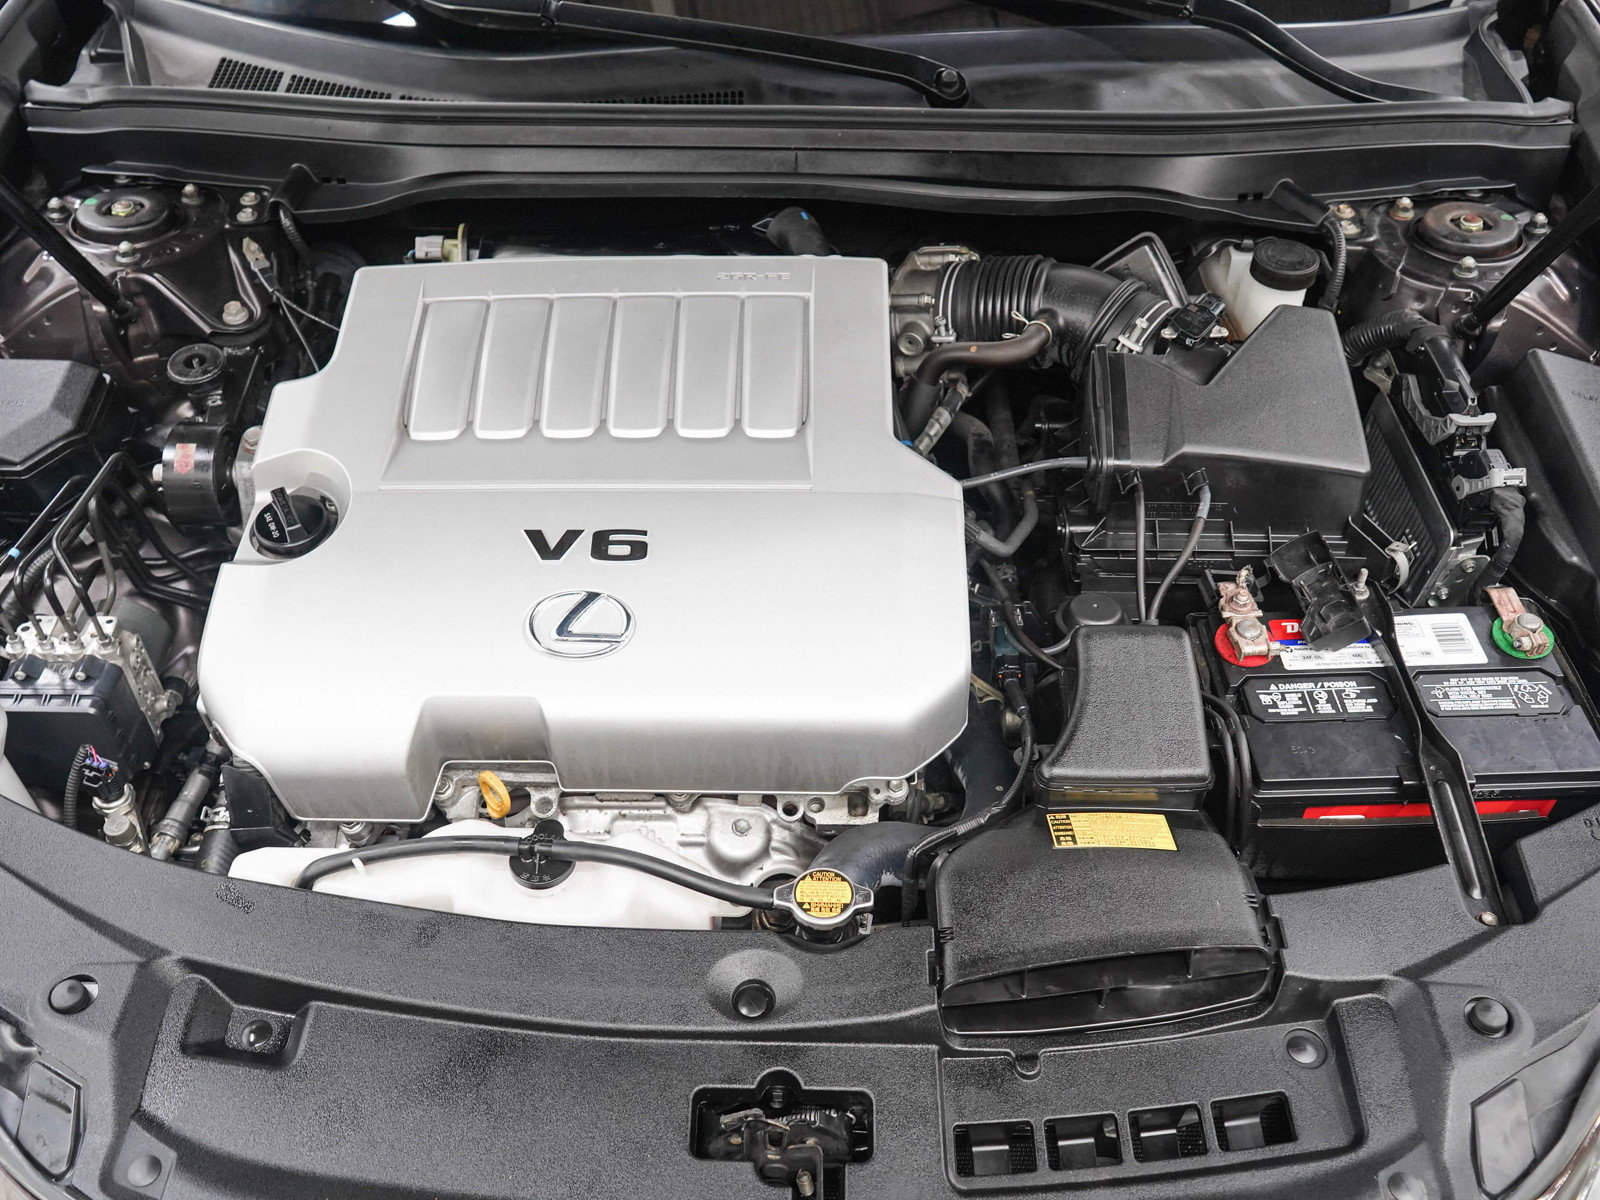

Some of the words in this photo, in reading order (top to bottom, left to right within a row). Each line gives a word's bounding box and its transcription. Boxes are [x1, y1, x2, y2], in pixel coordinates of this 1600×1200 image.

[263, 512, 274, 523] SAE
[268, 522, 280, 539] 0W-20
[523, 528, 649, 562] V6
